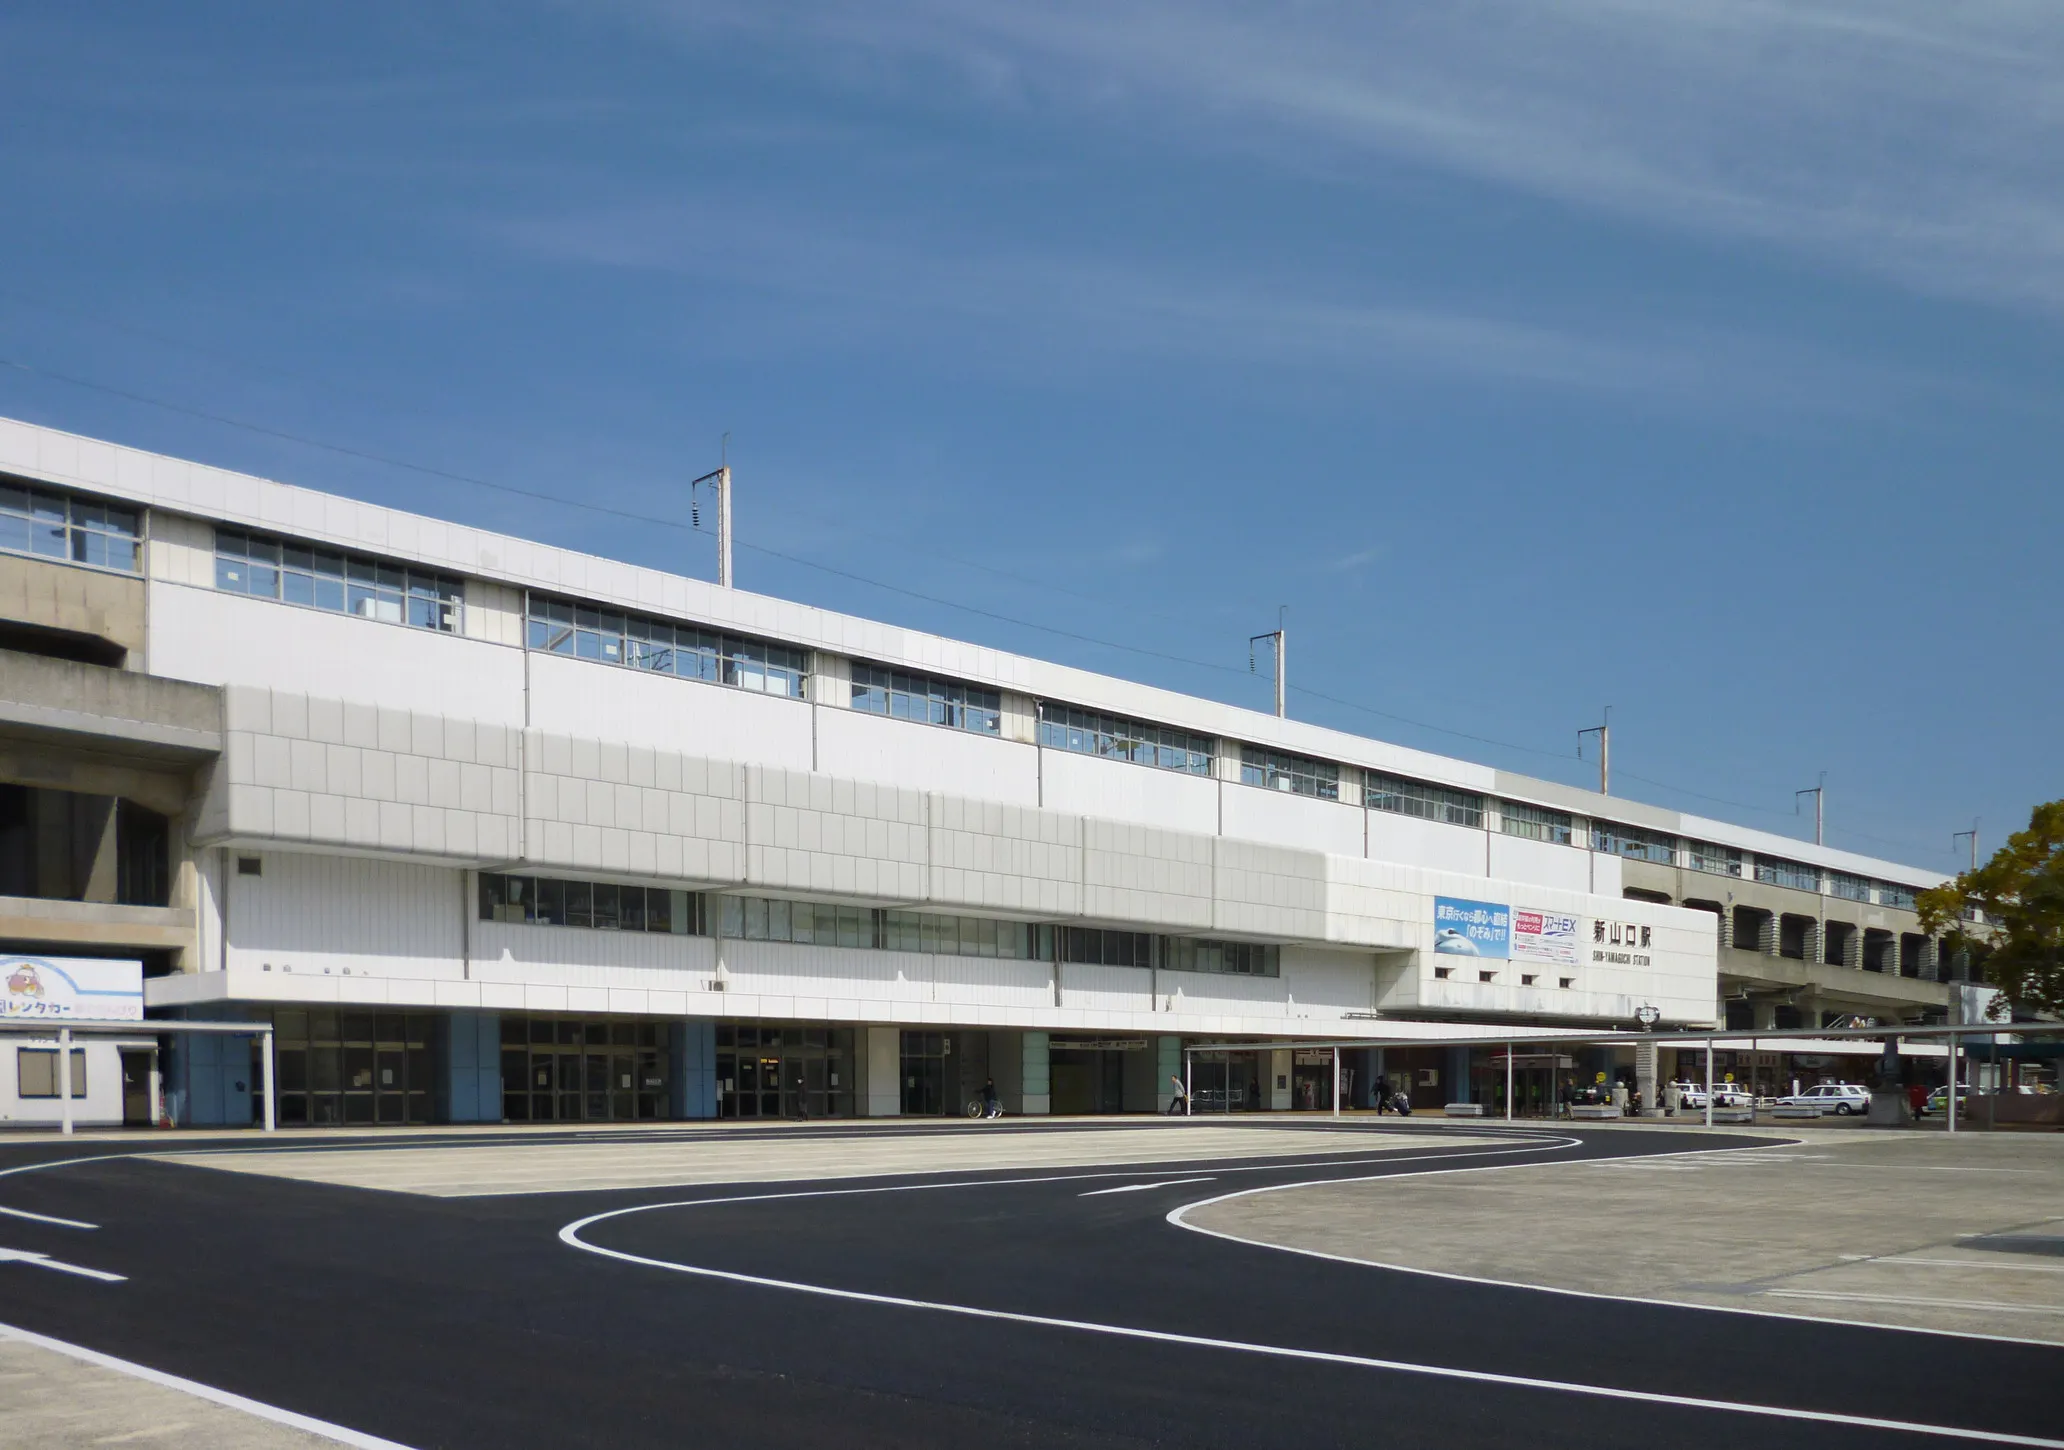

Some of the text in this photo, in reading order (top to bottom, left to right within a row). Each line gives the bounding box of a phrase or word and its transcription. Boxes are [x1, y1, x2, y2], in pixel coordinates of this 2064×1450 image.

[1544, 916, 1577, 932] スマートEX
[1593, 919, 1651, 948] 新山口駅
[1593, 950, 1631, 965] SHIN-YAMAGUCHI
[1633, 954, 1651, 967] STATION
